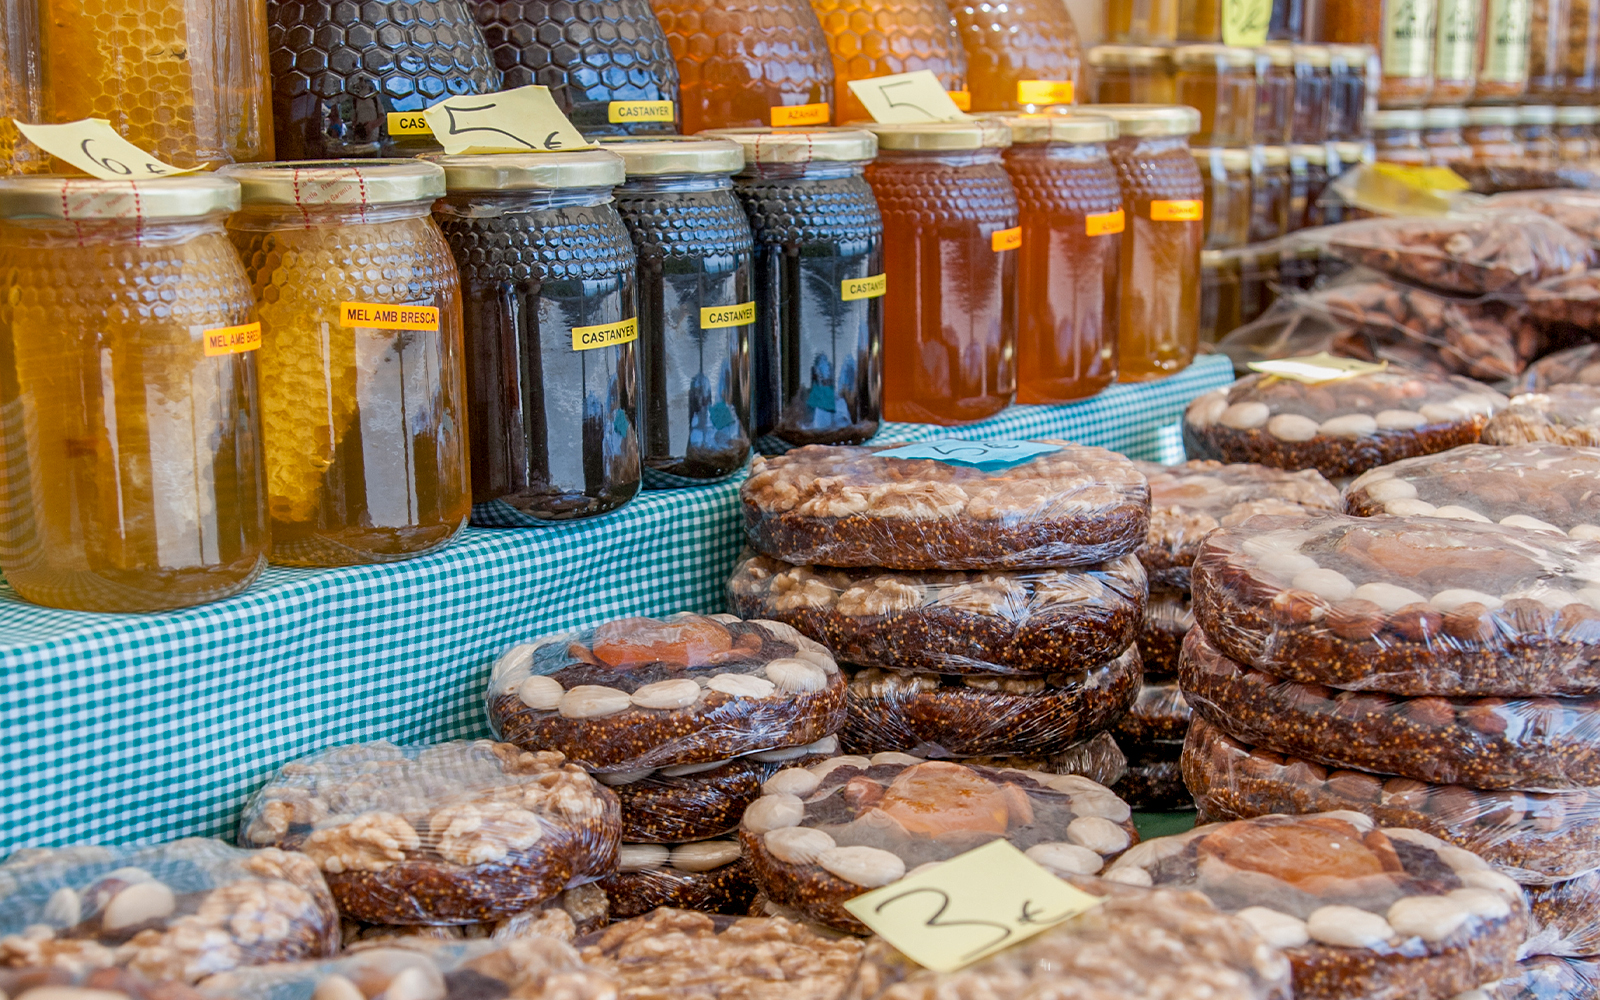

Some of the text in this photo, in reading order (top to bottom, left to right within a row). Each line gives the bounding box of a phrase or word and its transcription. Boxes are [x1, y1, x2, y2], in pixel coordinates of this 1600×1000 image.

[618, 106, 670, 117] CASTANYER
[400, 118, 429, 129] CAS
[347, 309, 436, 324] MEL AMB BRESCA
[709, 307, 753, 324] CASTANYER
[209, 335, 228, 348] MEL
[230, 332, 245, 345] AMB
[581, 325, 635, 345] CASTANYER
